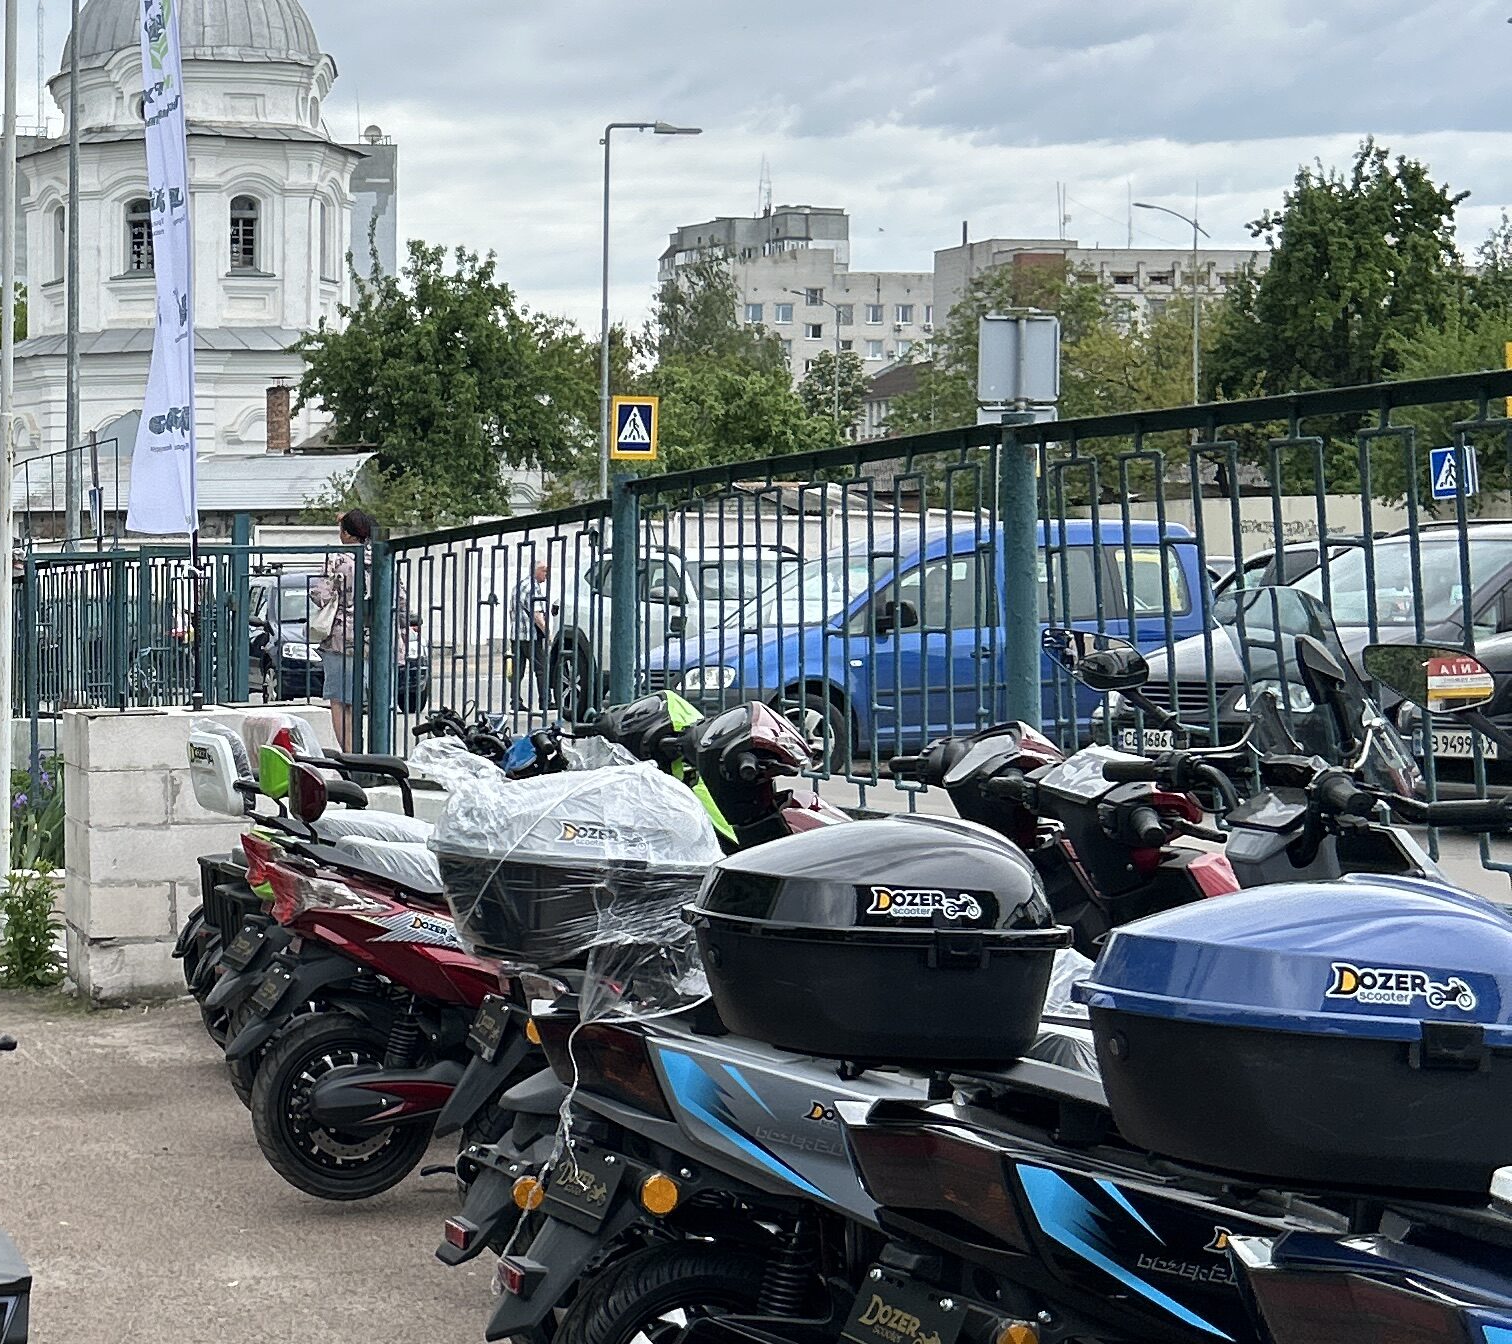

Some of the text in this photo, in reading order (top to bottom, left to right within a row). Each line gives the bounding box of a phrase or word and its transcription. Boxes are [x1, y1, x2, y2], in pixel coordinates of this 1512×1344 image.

[1442, 735, 1473, 754] 9499
[868, 888, 945, 912] DOZER
[892, 907, 931, 916] scooter
[1328, 965, 1427, 995] DOZER
[1359, 991, 1410, 1003] scooter
[857, 1293, 921, 1338] DOZER
